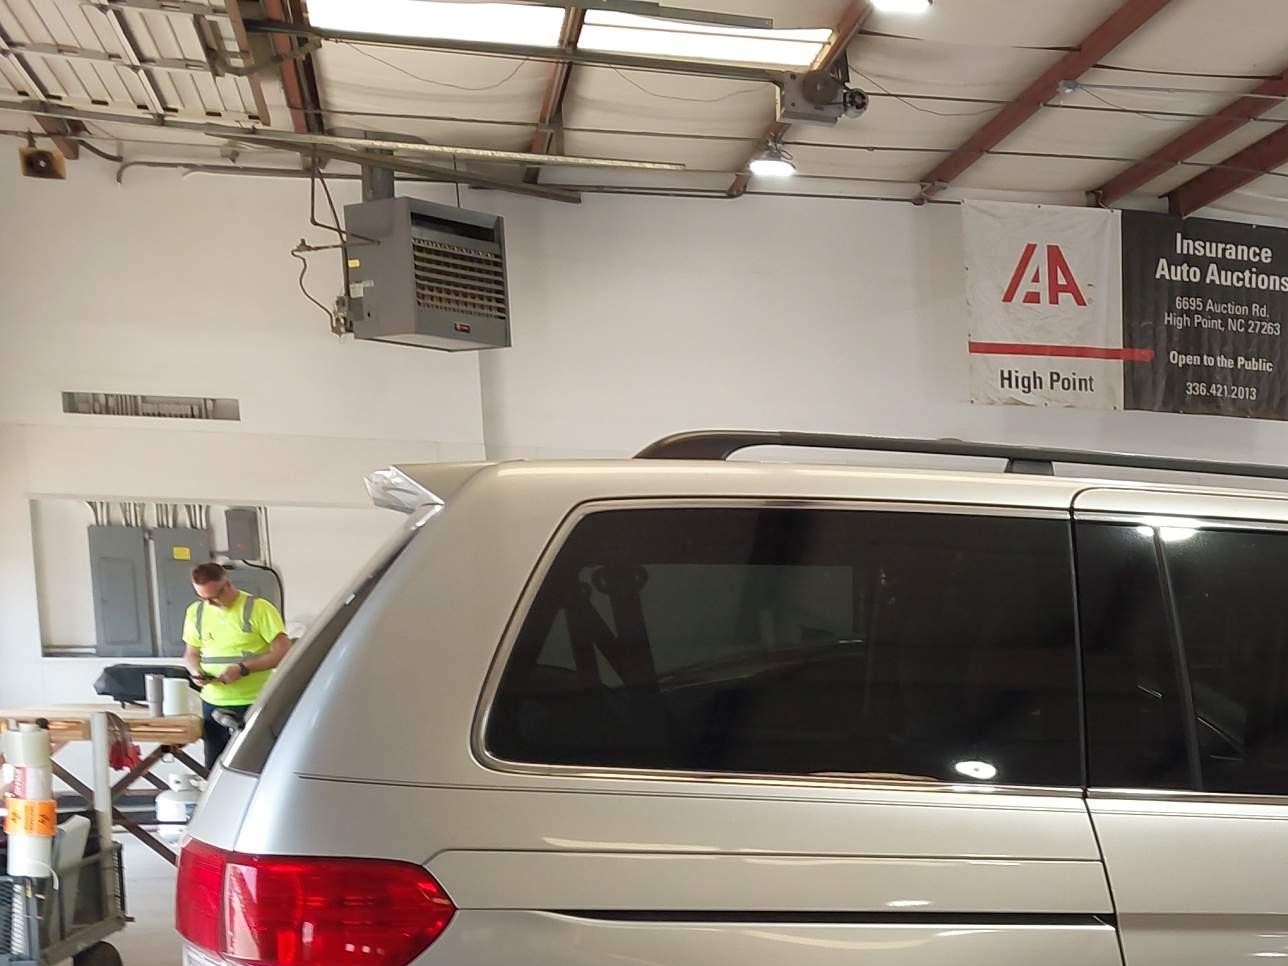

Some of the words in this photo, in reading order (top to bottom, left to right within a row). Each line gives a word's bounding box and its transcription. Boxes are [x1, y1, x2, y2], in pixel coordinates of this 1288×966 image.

[1176, 232, 1272, 264] Insurance
[1155, 258, 1201, 283] Auto
[1175, 296, 1203, 312] 6695
[1205, 298, 1249, 316] Auction
[1252, 303, 1270, 318] Rd.
[1165, 313, 1191, 330] High
[1194, 315, 1226, 333] Point,
[1228, 319, 1245, 333] NC
[1248, 320, 1281, 336] 27263
[1169, 350, 1201, 368] Open
[1203, 353, 1215, 367] to
[1216, 352, 1235, 369] the
[1237, 355, 1274, 373] Public
[999, 369, 1043, 394] High
[1050, 371, 1095, 393] Point
[1186, 382, 1257, 401] 336.421.2013
